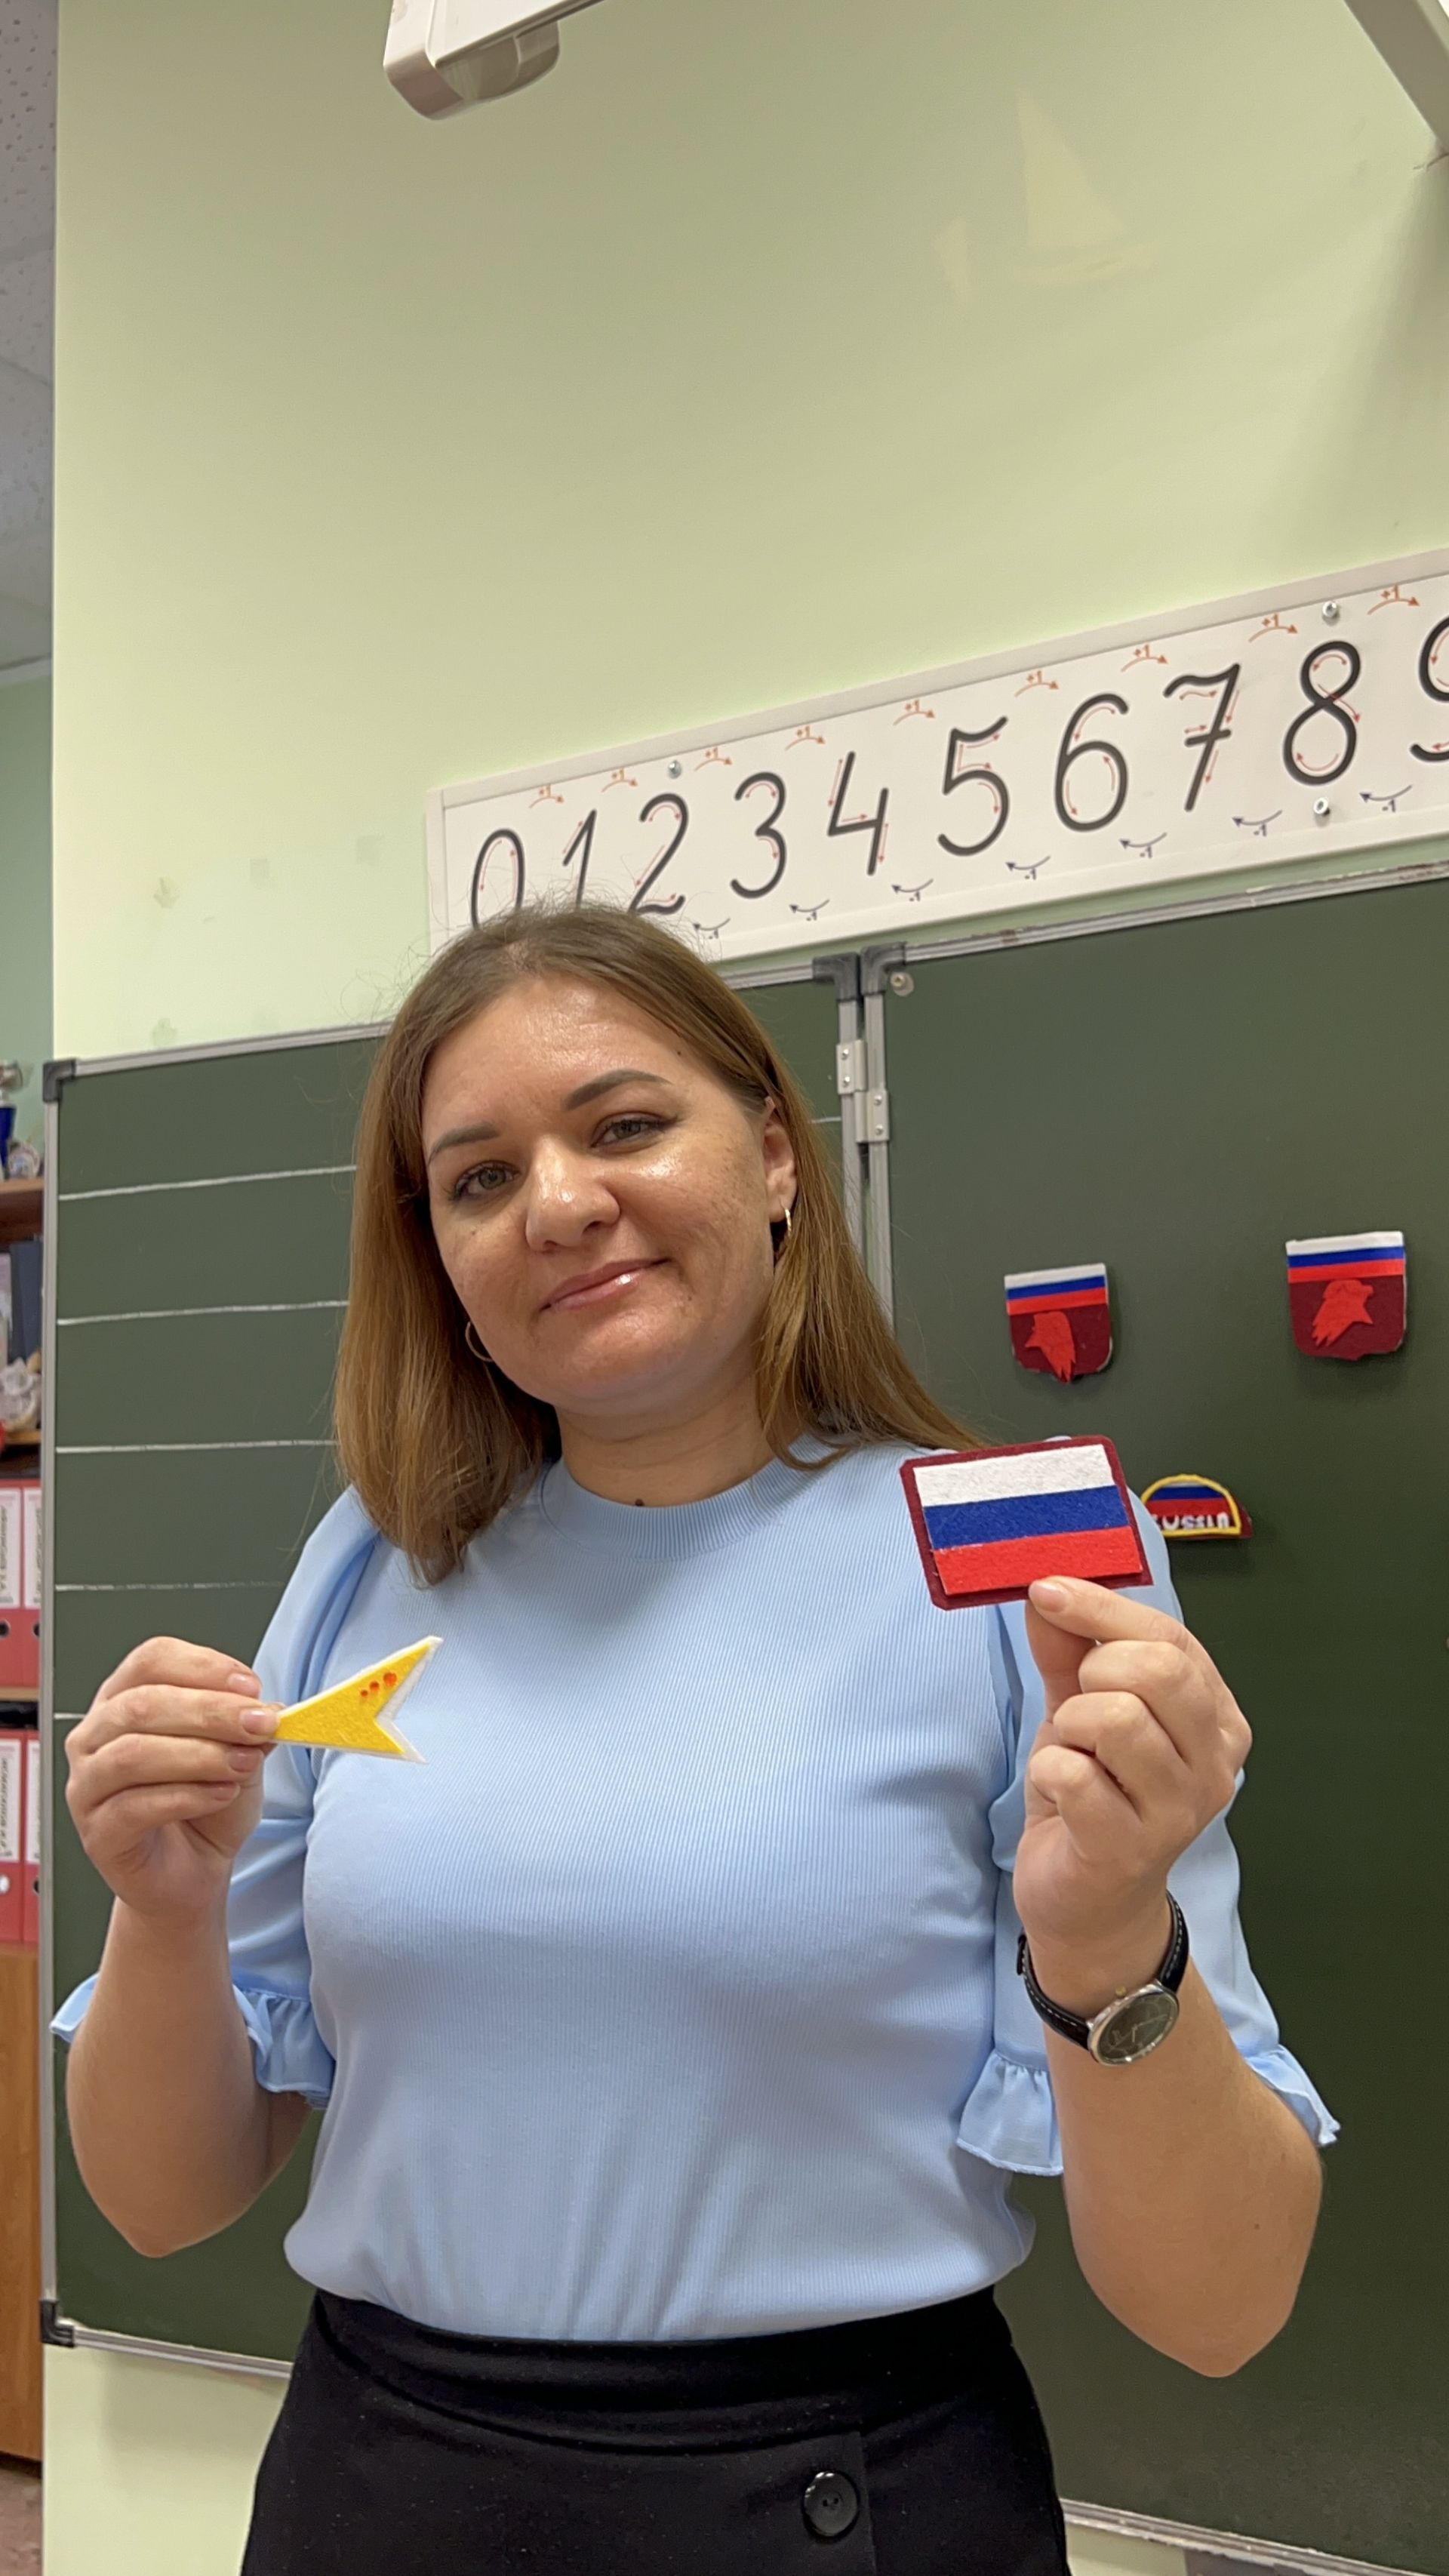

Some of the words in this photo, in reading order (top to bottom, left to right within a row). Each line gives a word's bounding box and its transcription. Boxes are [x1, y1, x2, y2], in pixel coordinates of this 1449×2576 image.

[905, 700, 919, 712] +1
[1026, 670, 1041, 683] +1
[1134, 645, 1149, 658] +1
[1262, 614, 1278, 627] +1
[1381, 584, 1398, 599] +1
[470, 828, 526, 931] 0
[562, 809, 597, 906] 1
[626, 792, 689, 916] 2
[731, 771, 786, 899] 3
[827, 751, 889, 876] 4
[937, 716, 1010, 857] 5
[1054, 693, 1129, 832] 6
[1163, 663, 1241, 811] 7
[1282, 640, 1361, 786] 8
[709, 928, 718, 939] -1
[806, 910, 817, 921] -1
[909, 890, 920, 901] -1
[1025, 868, 1036, 880] -1
[1140, 846, 1152, 858] -1
[1254, 823, 1266, 836] -1
[1382, 799, 1395, 812] -1
[1152, 1511, 1230, 1531] USSIA
